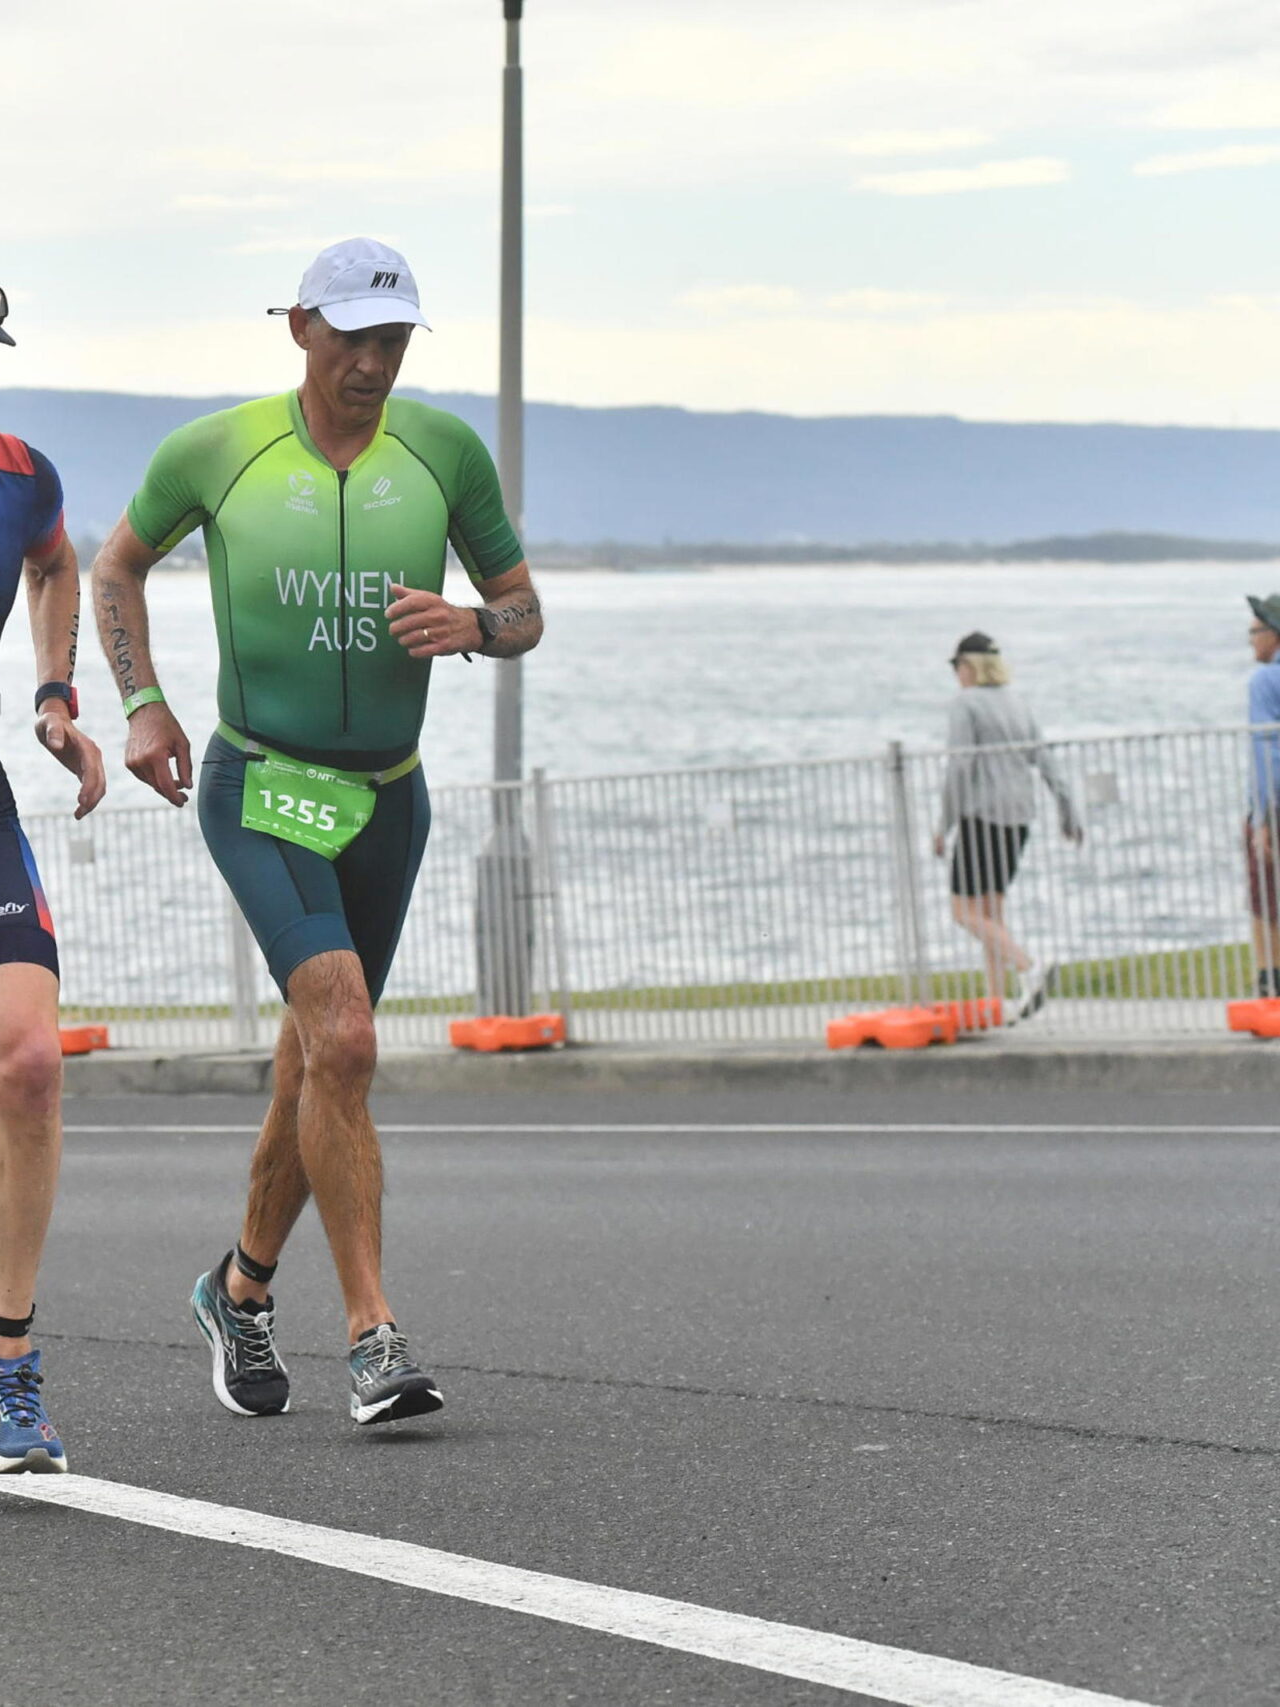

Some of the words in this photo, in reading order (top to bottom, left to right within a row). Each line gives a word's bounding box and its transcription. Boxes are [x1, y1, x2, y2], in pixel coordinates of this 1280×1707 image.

[370, 271, 399, 288] WYN
[275, 567, 405, 608] WYNEN
[308, 616, 377, 652] AUS
[317, 772, 336, 782] NTT
[259, 789, 337, 831] 1255
